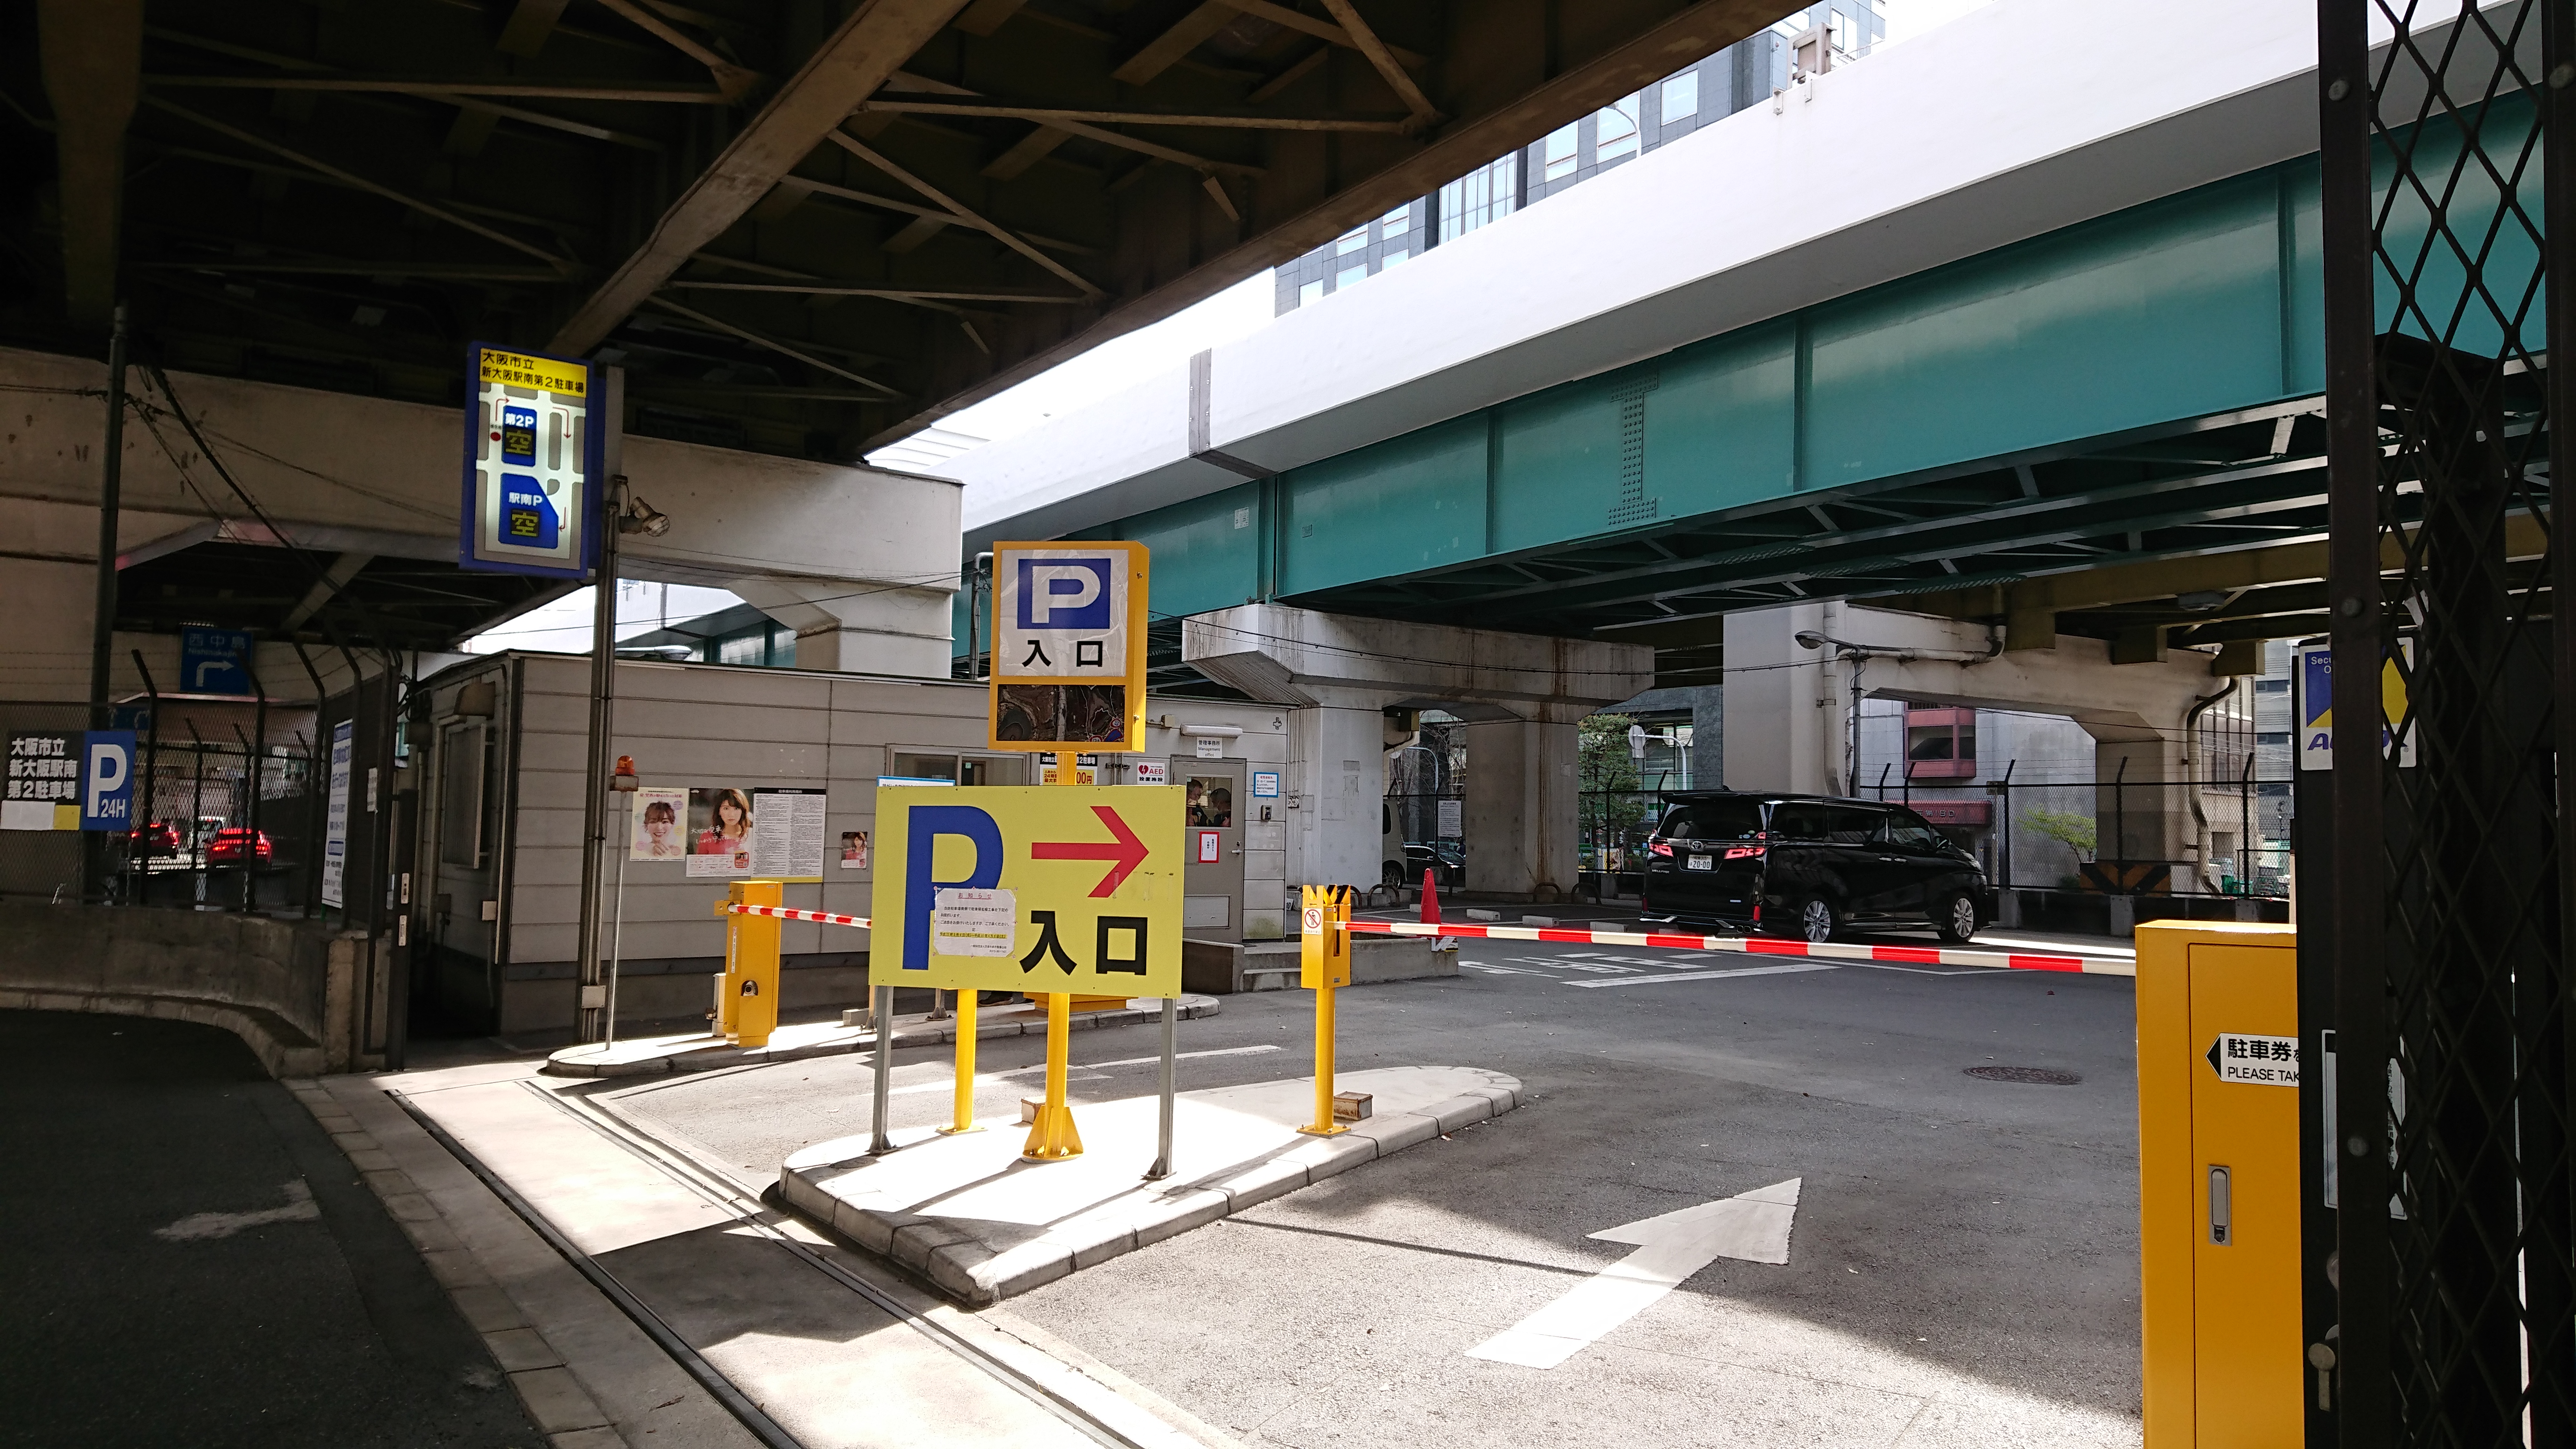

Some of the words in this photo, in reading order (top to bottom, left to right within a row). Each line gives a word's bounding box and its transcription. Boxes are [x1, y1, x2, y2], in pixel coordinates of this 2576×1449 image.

[483, 351, 534, 370] 大阪市立
[505, 430, 532, 456] 空
[509, 492, 543, 506] 駅南P
[511, 512, 538, 537] 空
[1031, 565, 1101, 624] P
[1022, 640, 1103, 668] 入口
[11, 737, 65, 756] 大阪市立
[9, 759, 78, 778] 新大阪駅南
[7, 780, 76, 800] 第2駐車場
[87, 744, 127, 818] P
[101, 799, 126, 818] 24H
[902, 805, 1004, 970] P
[1018, 910, 1148, 976] 入口
[2228, 1067, 2275, 1081] PLEASE
